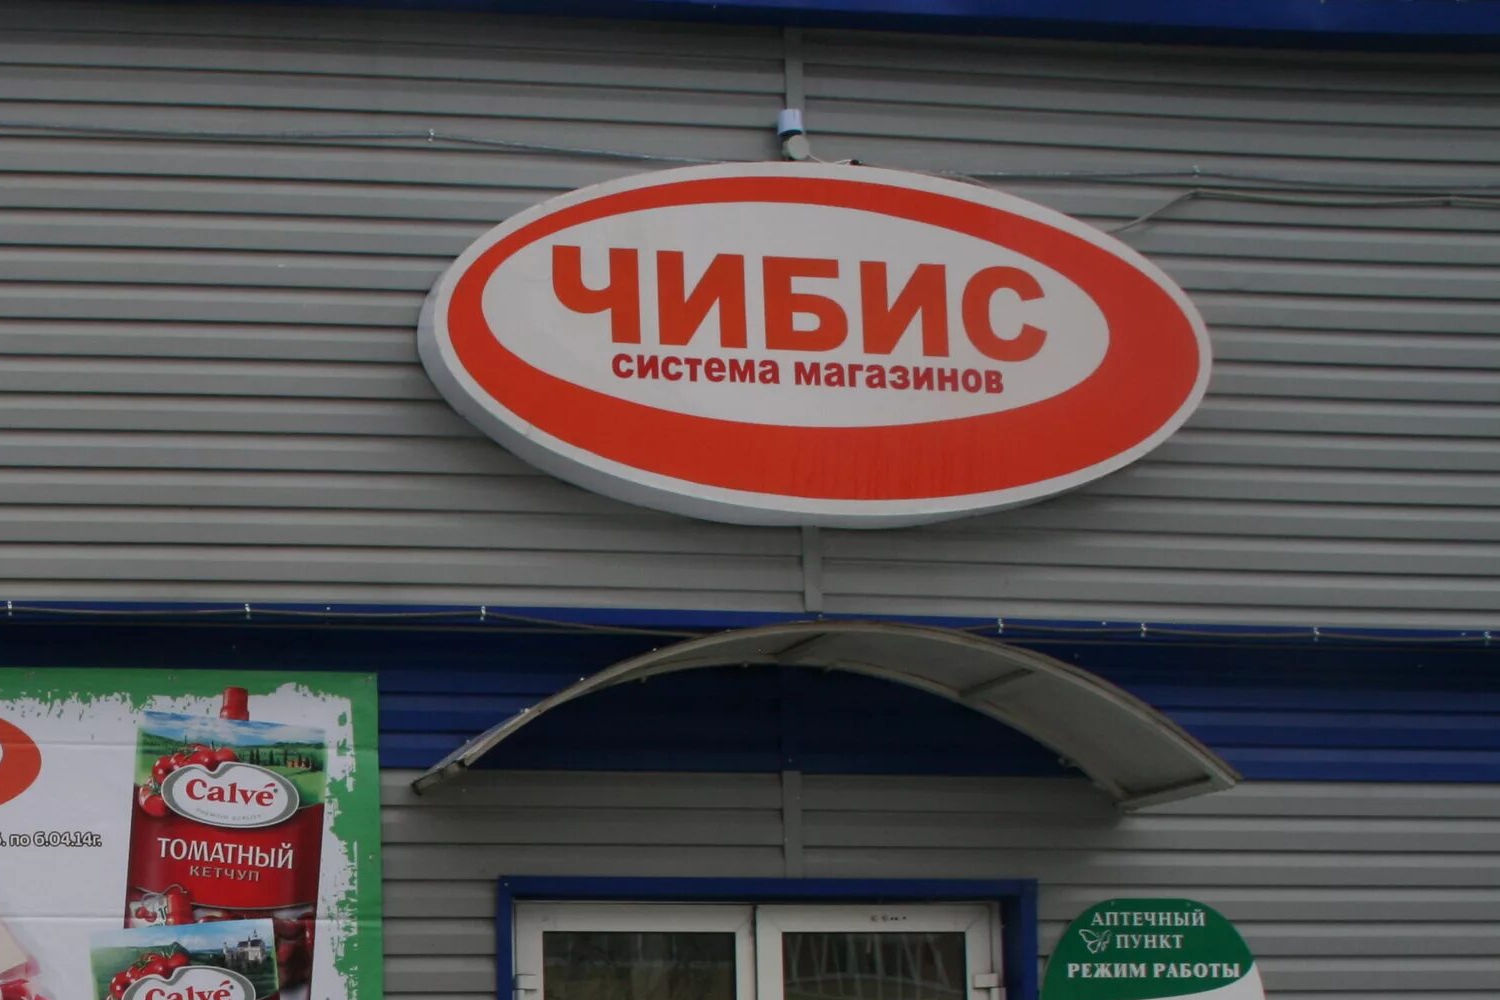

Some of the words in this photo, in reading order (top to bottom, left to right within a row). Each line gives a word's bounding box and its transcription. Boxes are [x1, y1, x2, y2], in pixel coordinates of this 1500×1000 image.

[551, 244, 1048, 362] ЧИБИС
[611, 352, 780, 384] система
[794, 361, 1005, 394] магазинов
[185, 778, 277, 807] Calvé
[9, 834, 31, 847] по
[157, 838, 294, 869] ТОМАТНЫЙ
[189, 866, 260, 881] КЕТЧУП
[1090, 909, 1206, 926] АПТЕЧНЫЙ
[1115, 934, 1184, 949] ПУНКТ
[1067, 962, 1147, 979] РЕЖИМ
[1153, 962, 1241, 978] РАБОТЫ
